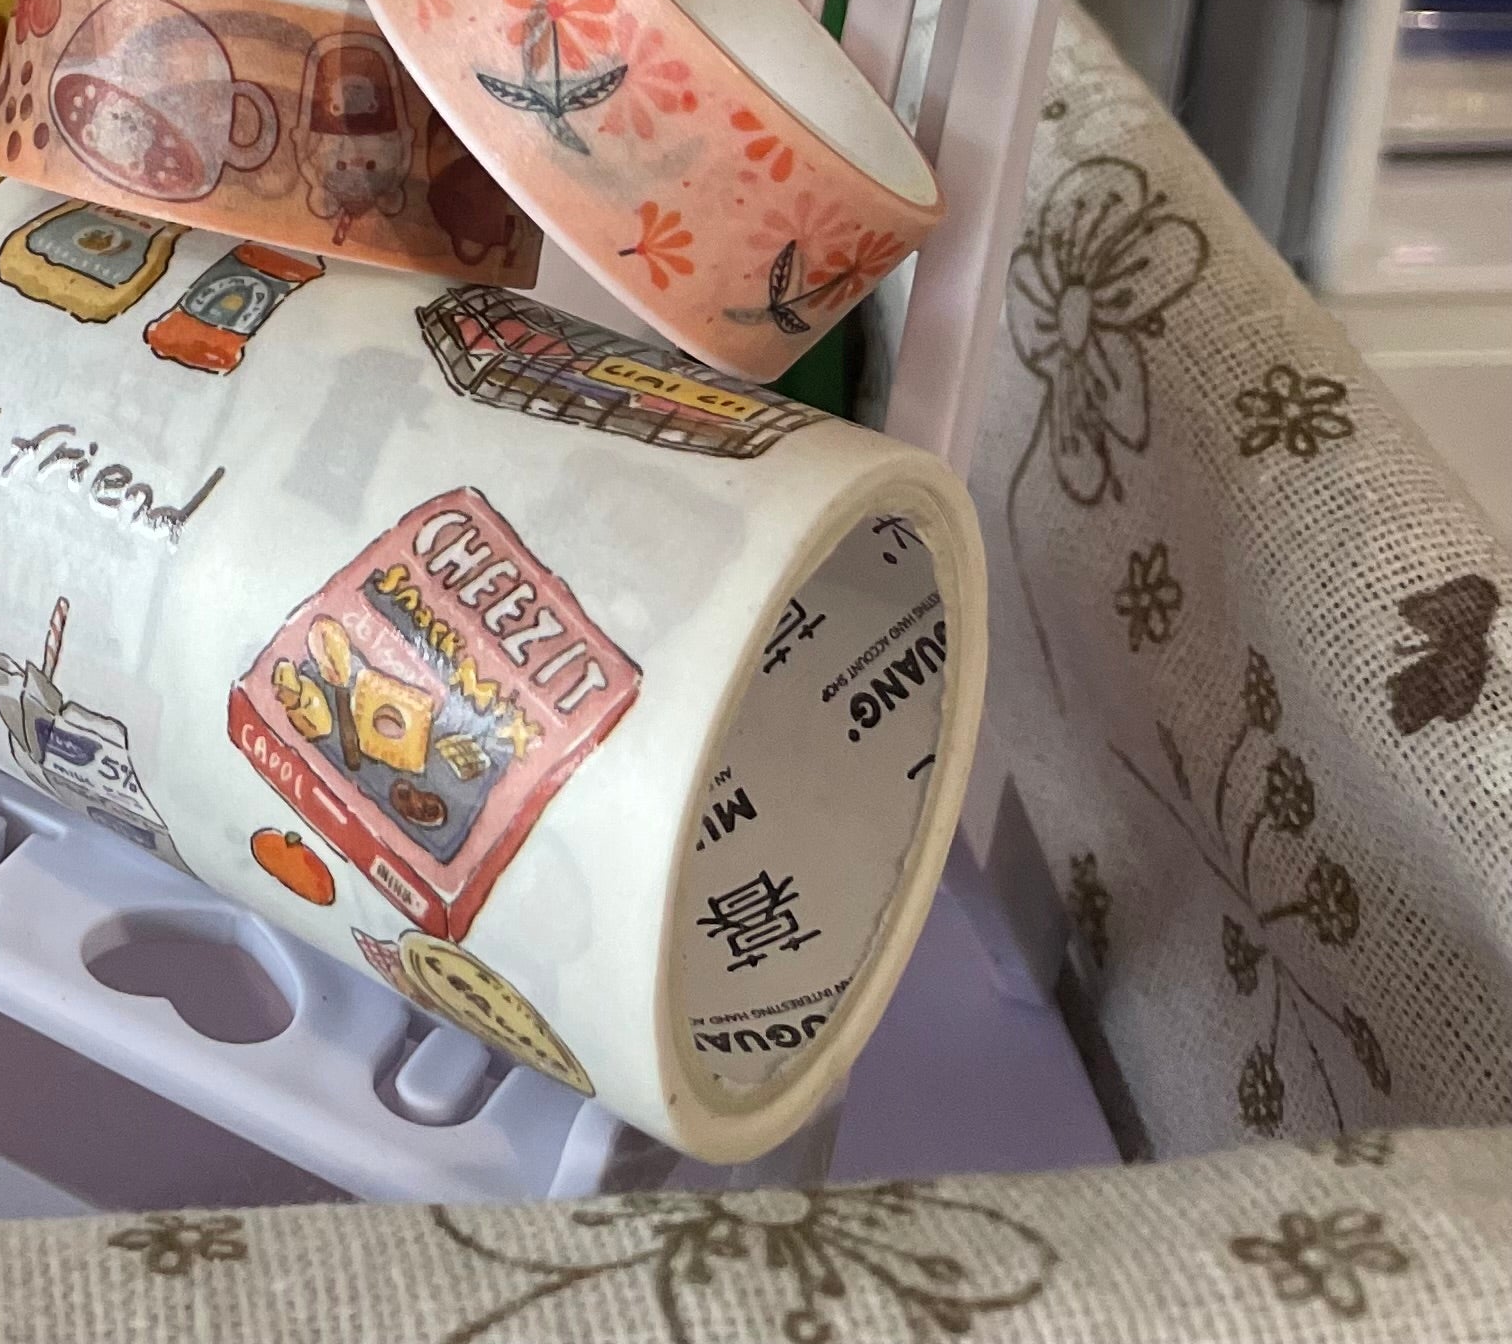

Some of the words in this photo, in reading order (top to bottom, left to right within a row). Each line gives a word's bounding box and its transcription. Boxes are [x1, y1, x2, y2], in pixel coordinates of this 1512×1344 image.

[1, 424, 226, 546] friend
[97, 755, 138, 793] 5%
[695, 869, 823, 973] 暮
[751, 985, 835, 1018] INTERESTING
